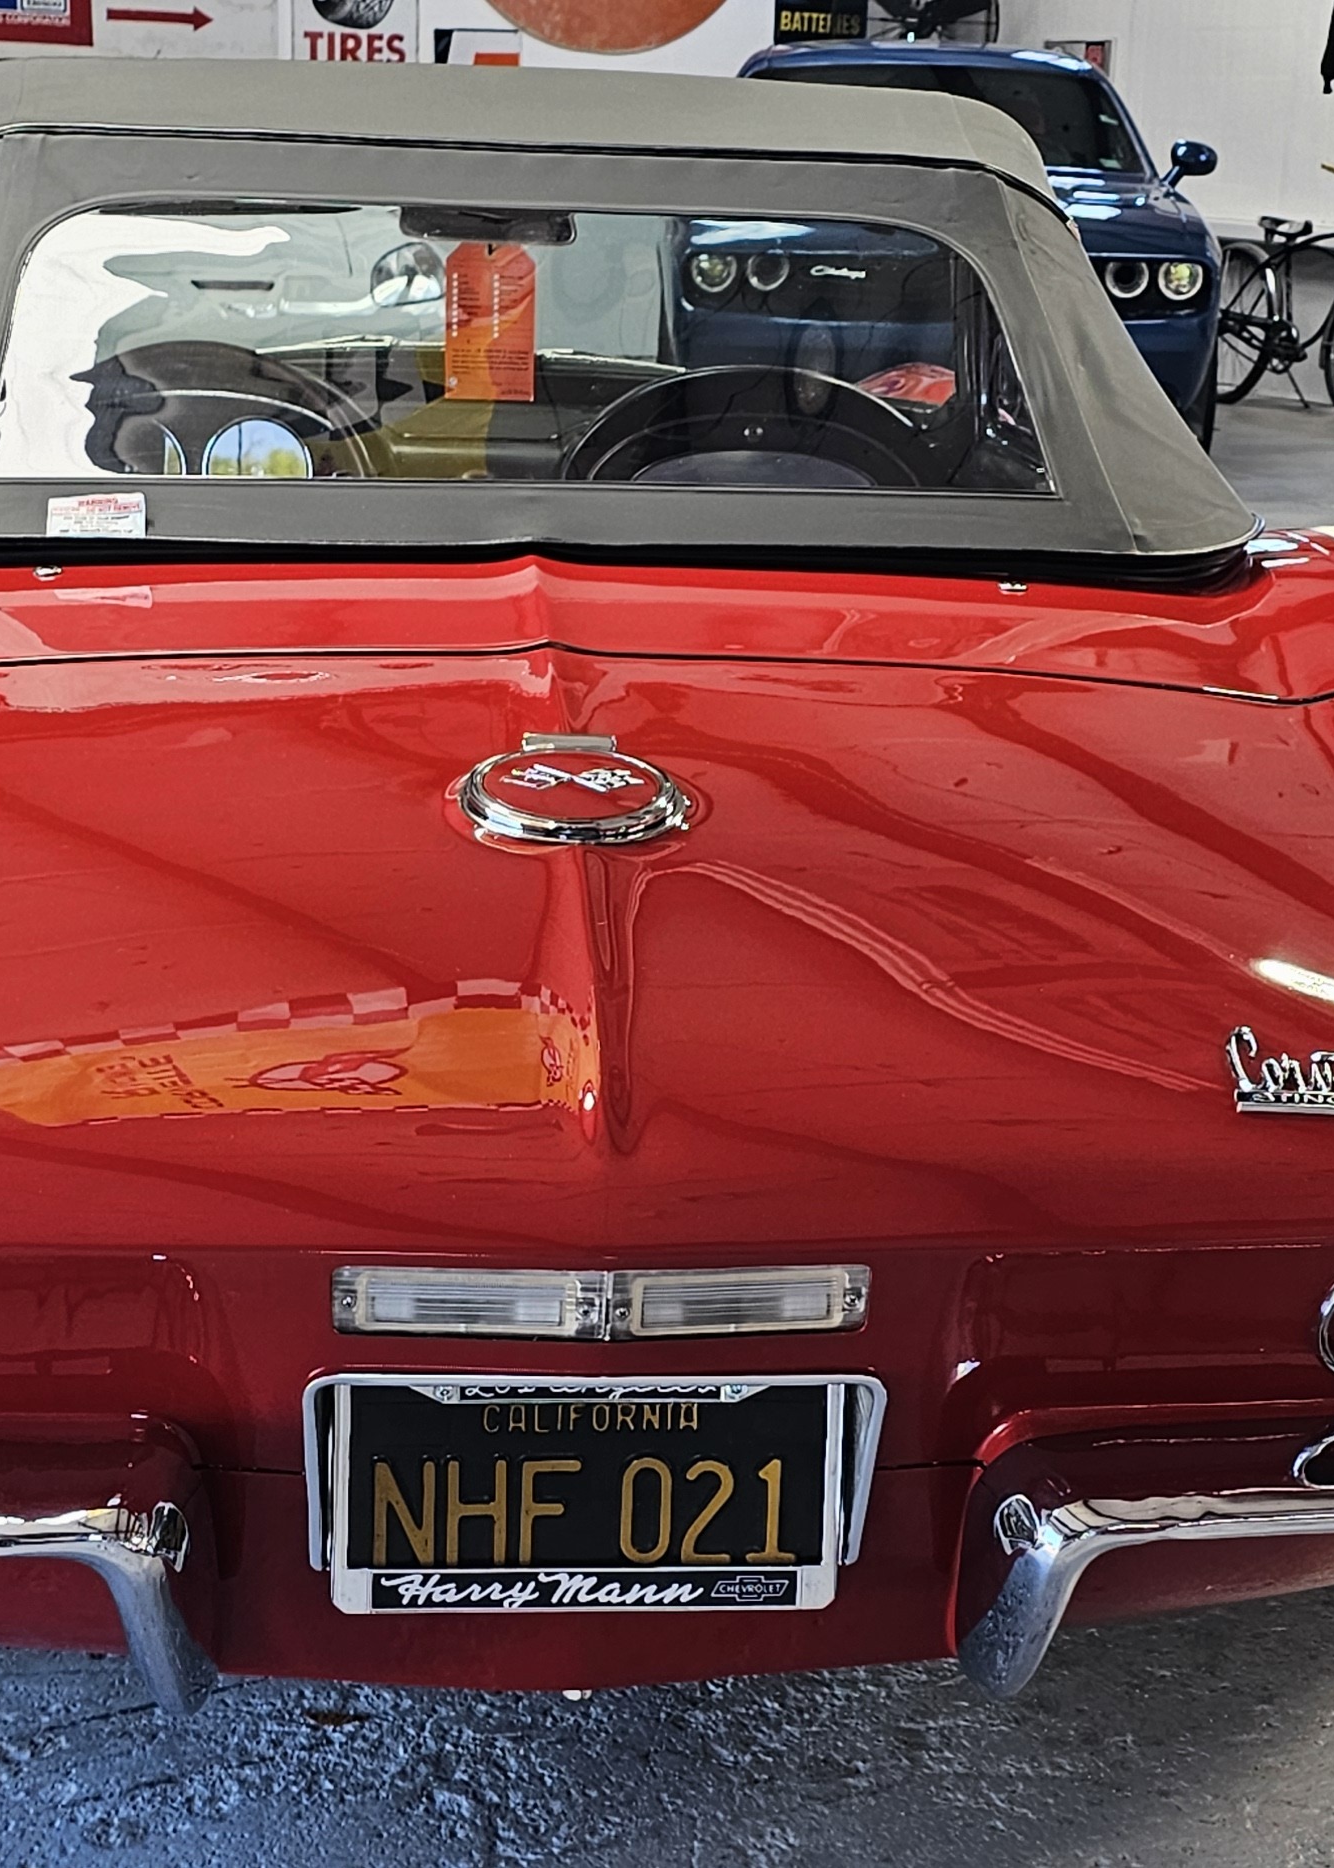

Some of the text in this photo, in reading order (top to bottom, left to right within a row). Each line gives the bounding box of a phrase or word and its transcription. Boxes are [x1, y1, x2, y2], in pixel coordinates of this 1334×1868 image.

[304, 31, 406, 63] TIRES
[483, 1403, 699, 1433] CALIFORNIA
[372, 1456, 797, 1567] NHF 021
[380, 1572, 704, 1608] Harry Mann
[719, 1583, 781, 1594] CHEVROLET
